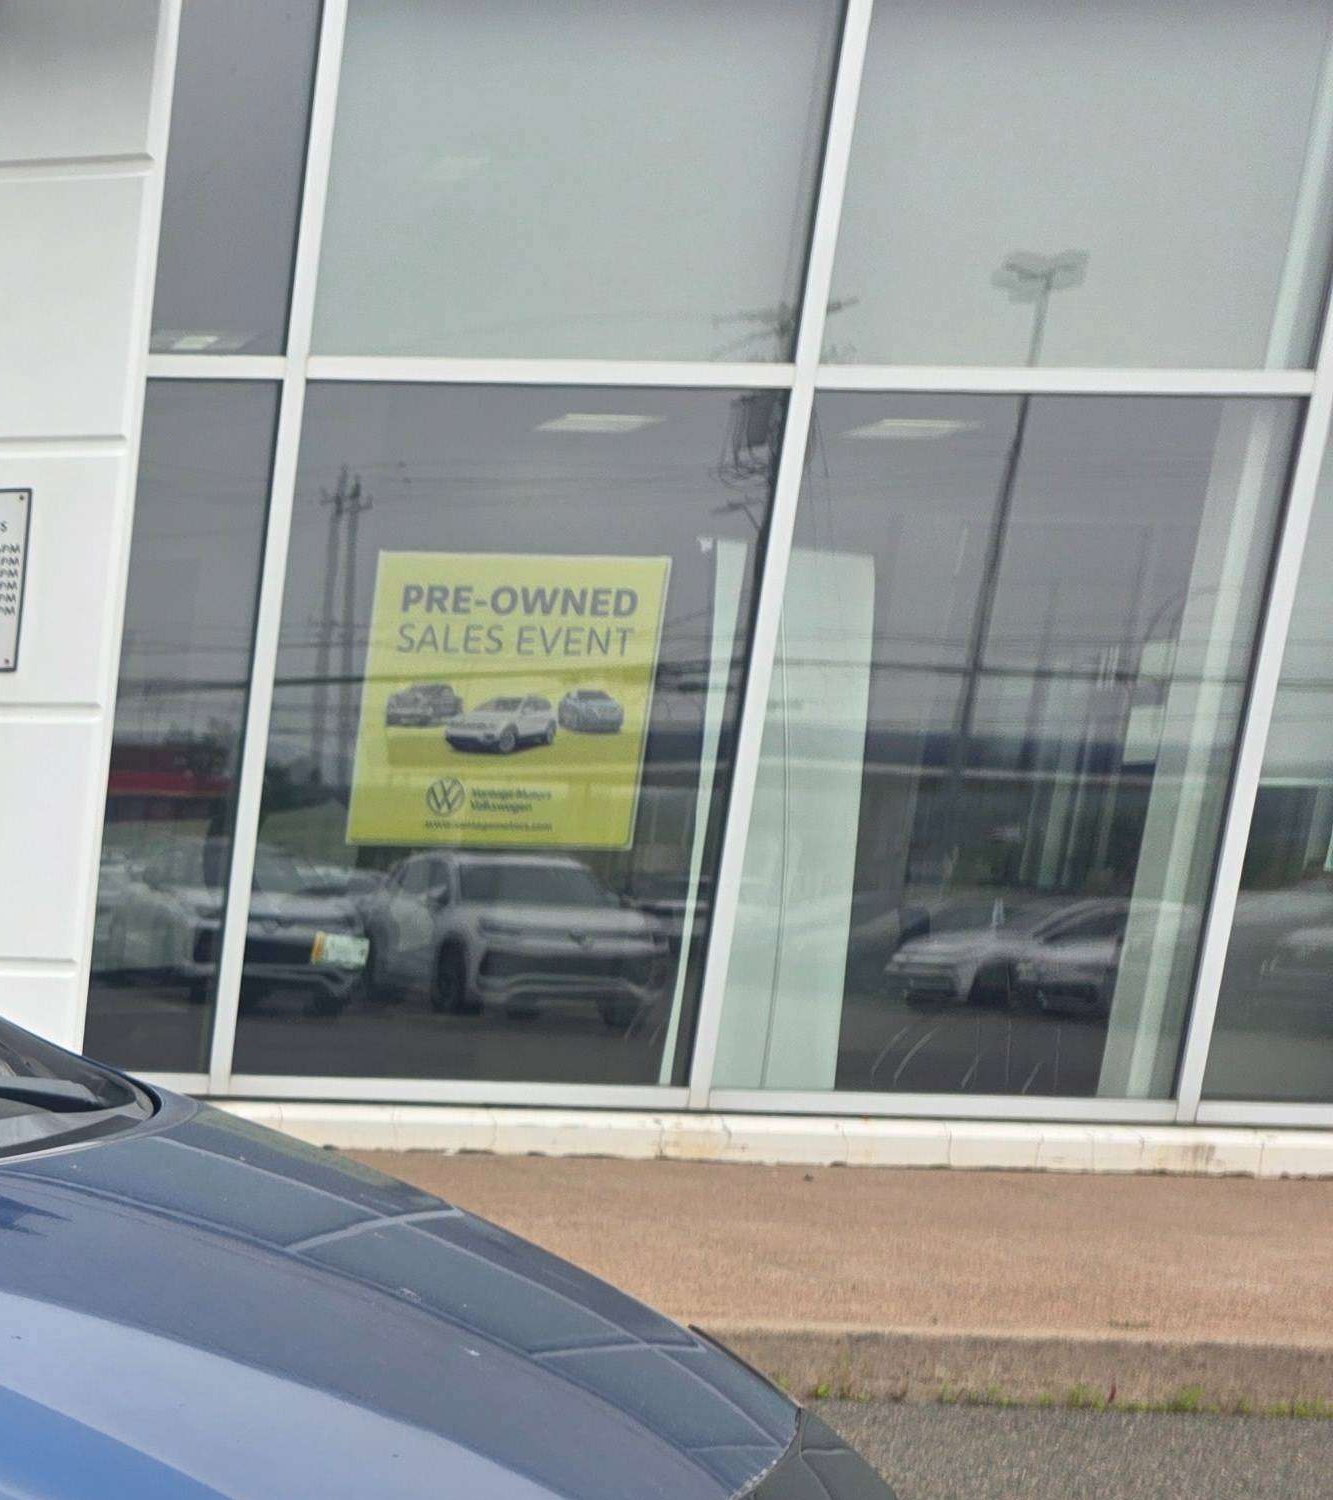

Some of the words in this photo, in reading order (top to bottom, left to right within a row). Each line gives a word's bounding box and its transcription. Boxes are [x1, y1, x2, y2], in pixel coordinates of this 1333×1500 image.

[401, 584, 639, 618] PRE-OWNED
[396, 623, 504, 656] SALES
[516, 626, 636, 658] EVENT
